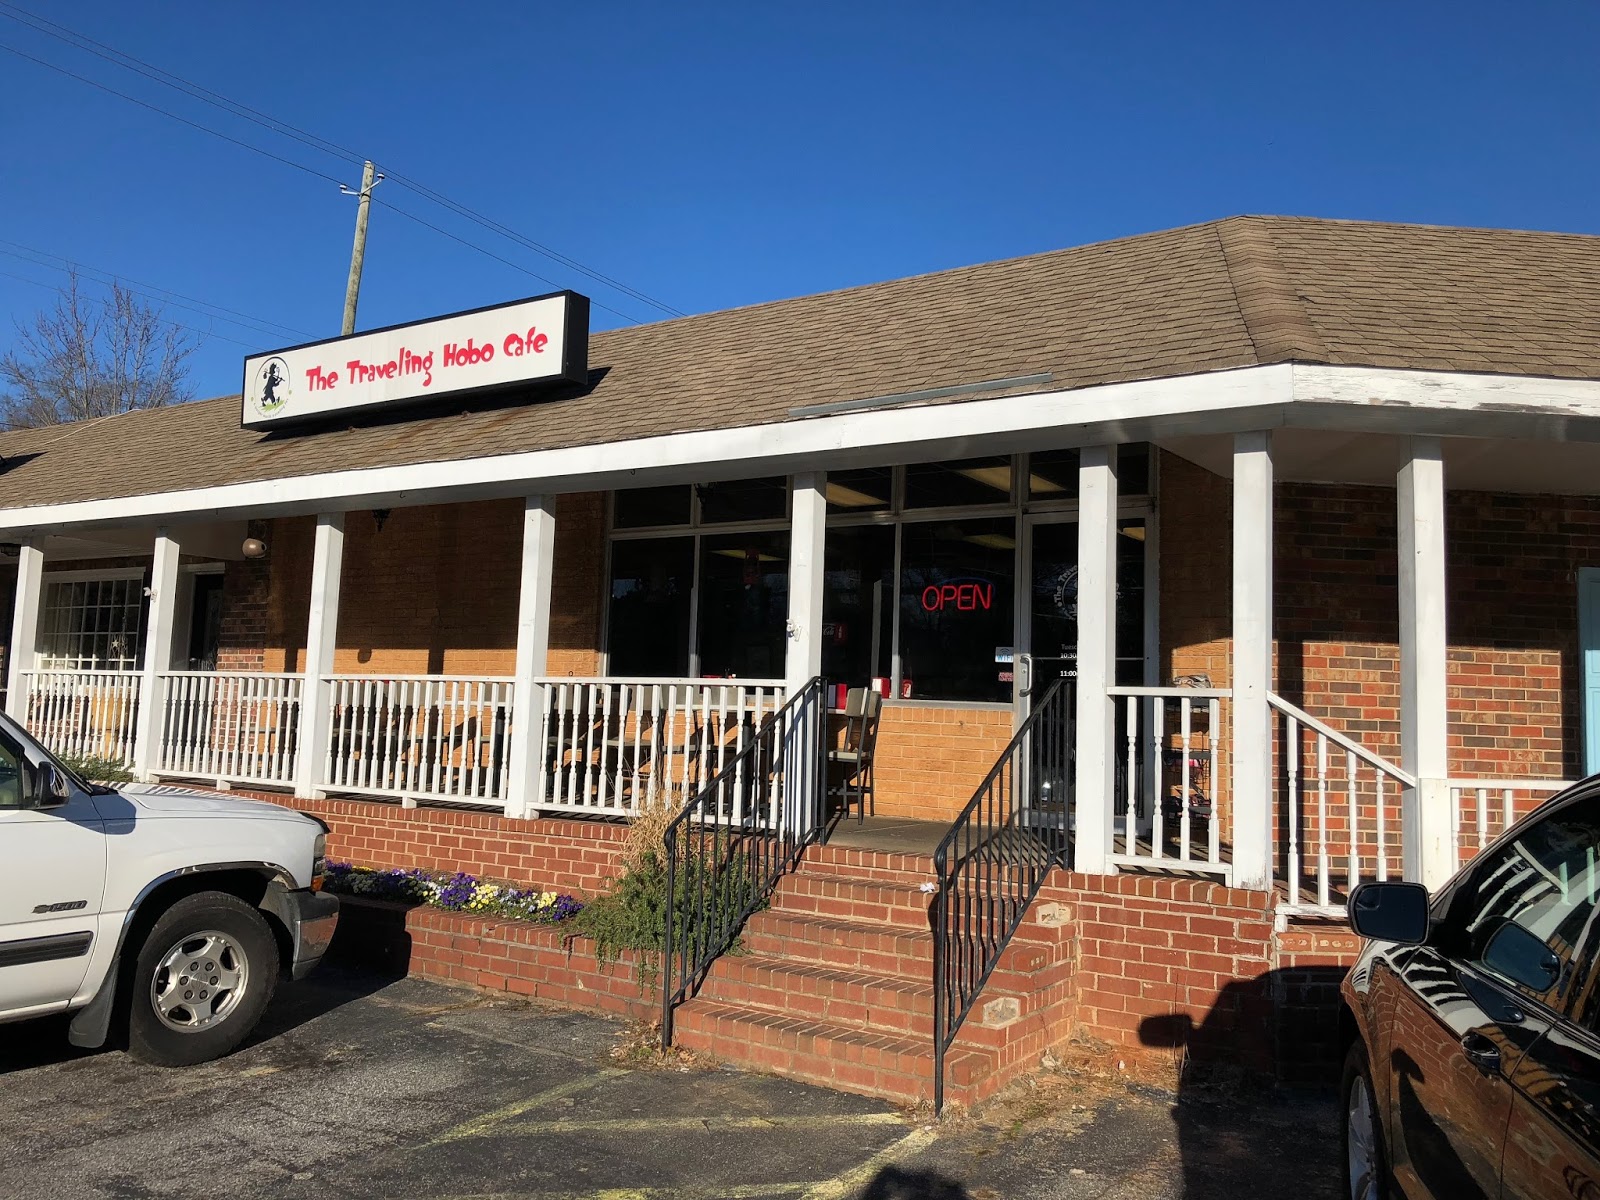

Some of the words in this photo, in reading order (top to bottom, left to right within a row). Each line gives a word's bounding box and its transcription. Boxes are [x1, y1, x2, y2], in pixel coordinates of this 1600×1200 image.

[305, 365, 339, 392] The
[346, 347, 434, 387] Traveling
[443, 338, 495, 368] Hobo
[503, 326, 549, 357] Cafe
[1057, 565, 1077, 582] Trave
[922, 584, 992, 611] OPEN
[1053, 585, 1063, 603] The
[51, 901, 87, 912] 1500
